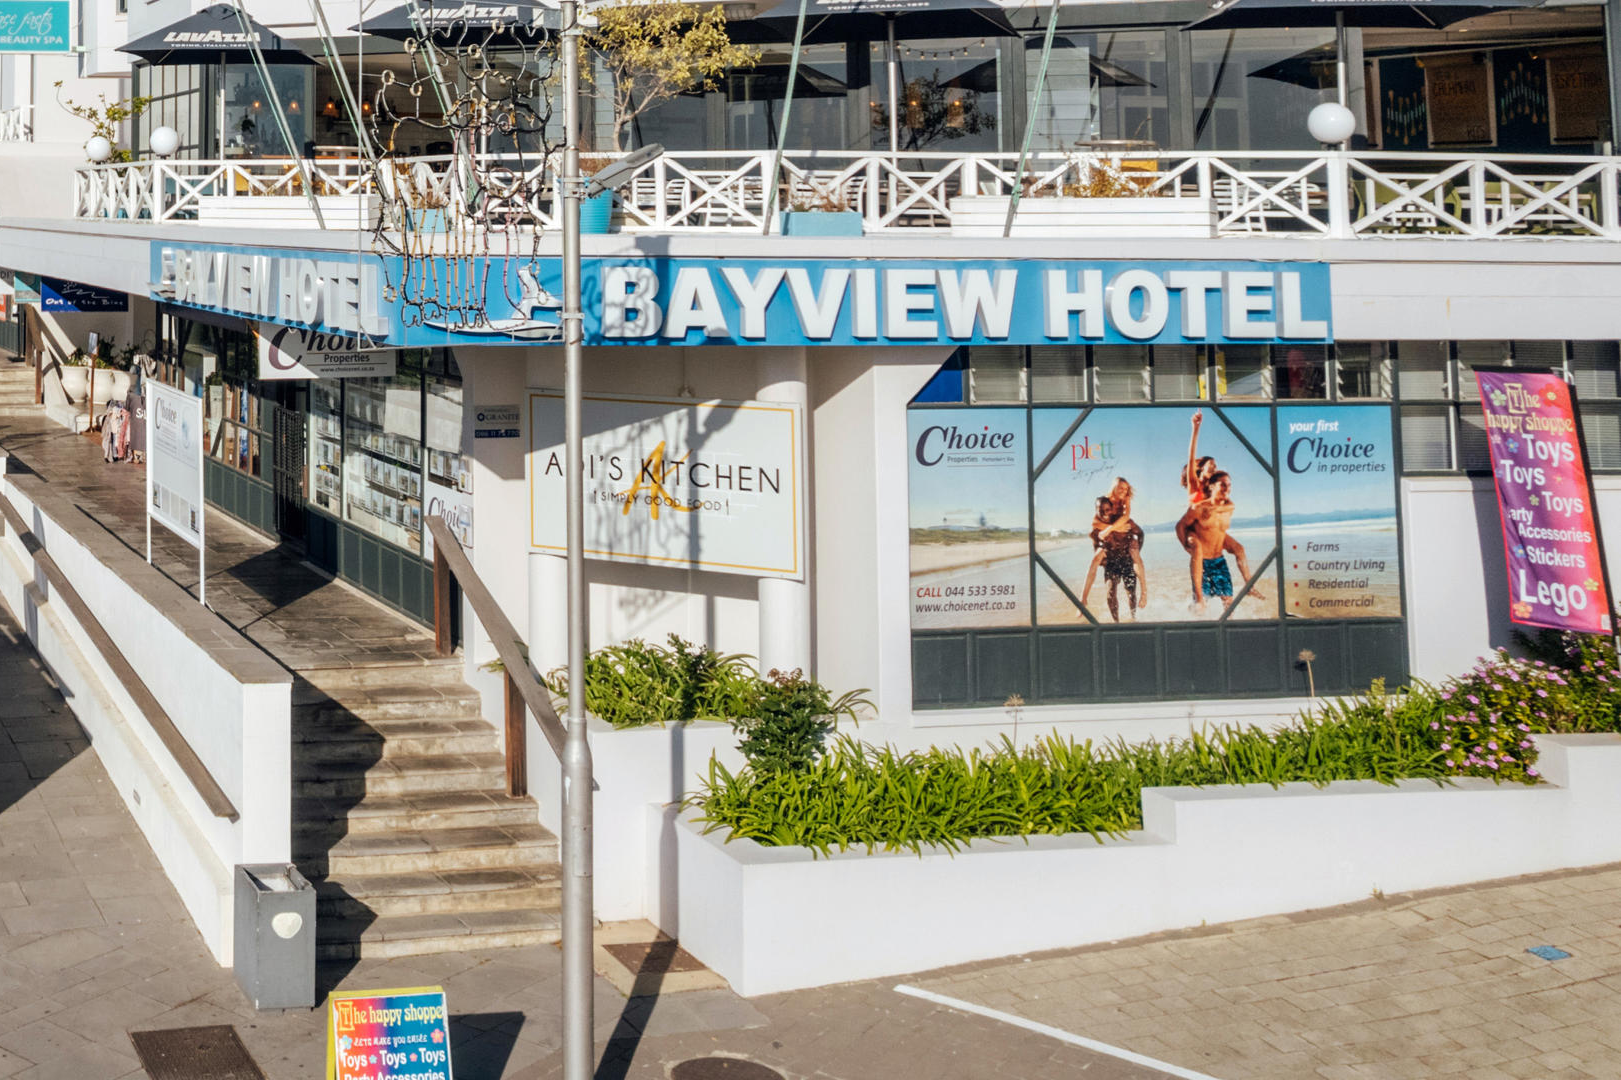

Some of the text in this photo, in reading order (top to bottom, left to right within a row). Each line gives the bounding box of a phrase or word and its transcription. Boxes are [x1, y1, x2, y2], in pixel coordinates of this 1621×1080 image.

[407, 4, 519, 21] LAVAZZA
[0, 35, 63, 44] BEAUTY SPA
[163, 30, 261, 43] LAVAZZA
[176, 248, 278, 318] BAYVIEW
[279, 257, 389, 336] HOTEL
[601, 267, 1327, 341] BAYVIEW HOTEL
[324, 353, 370, 365] Properties
[1504, 383, 1541, 414] The
[1289, 420, 1339, 434] your first
[1485, 409, 1574, 436] happy shoppe
[915, 425, 1015, 466] Choice
[1071, 436, 1116, 471] plett
[1287, 436, 1375, 474] Choice
[1522, 433, 1575, 468] Toys
[947, 455, 978, 464] Properties
[1317, 461, 1386, 474] in properties
[544, 451, 780, 494] AI'S KITCHEN
[1500, 459, 1546, 490] Toys
[601, 491, 721, 511] SIMPLY GOOD FOOD
[1542, 491, 1585, 518] Toys
[1508, 507, 1534, 525] arty
[1518, 522, 1593, 543] Accessories
[1306, 541, 1340, 552] Farms
[1526, 545, 1587, 569] Stickers
[1307, 559, 1385, 572] Country Living
[916, 585, 1016, 598] CALL 044 533 5981
[1308, 577, 1369, 589] Residential
[1519, 569, 1587, 617] Lego
[916, 600, 1016, 613] www.choicenet.co.za
[1309, 596, 1374, 609] Commercial
[337, 1001, 443, 1031] The happy shoppe
[373, 1036, 392, 1046] MAKE
[340, 1047, 446, 1071] Toys Toys Toys
